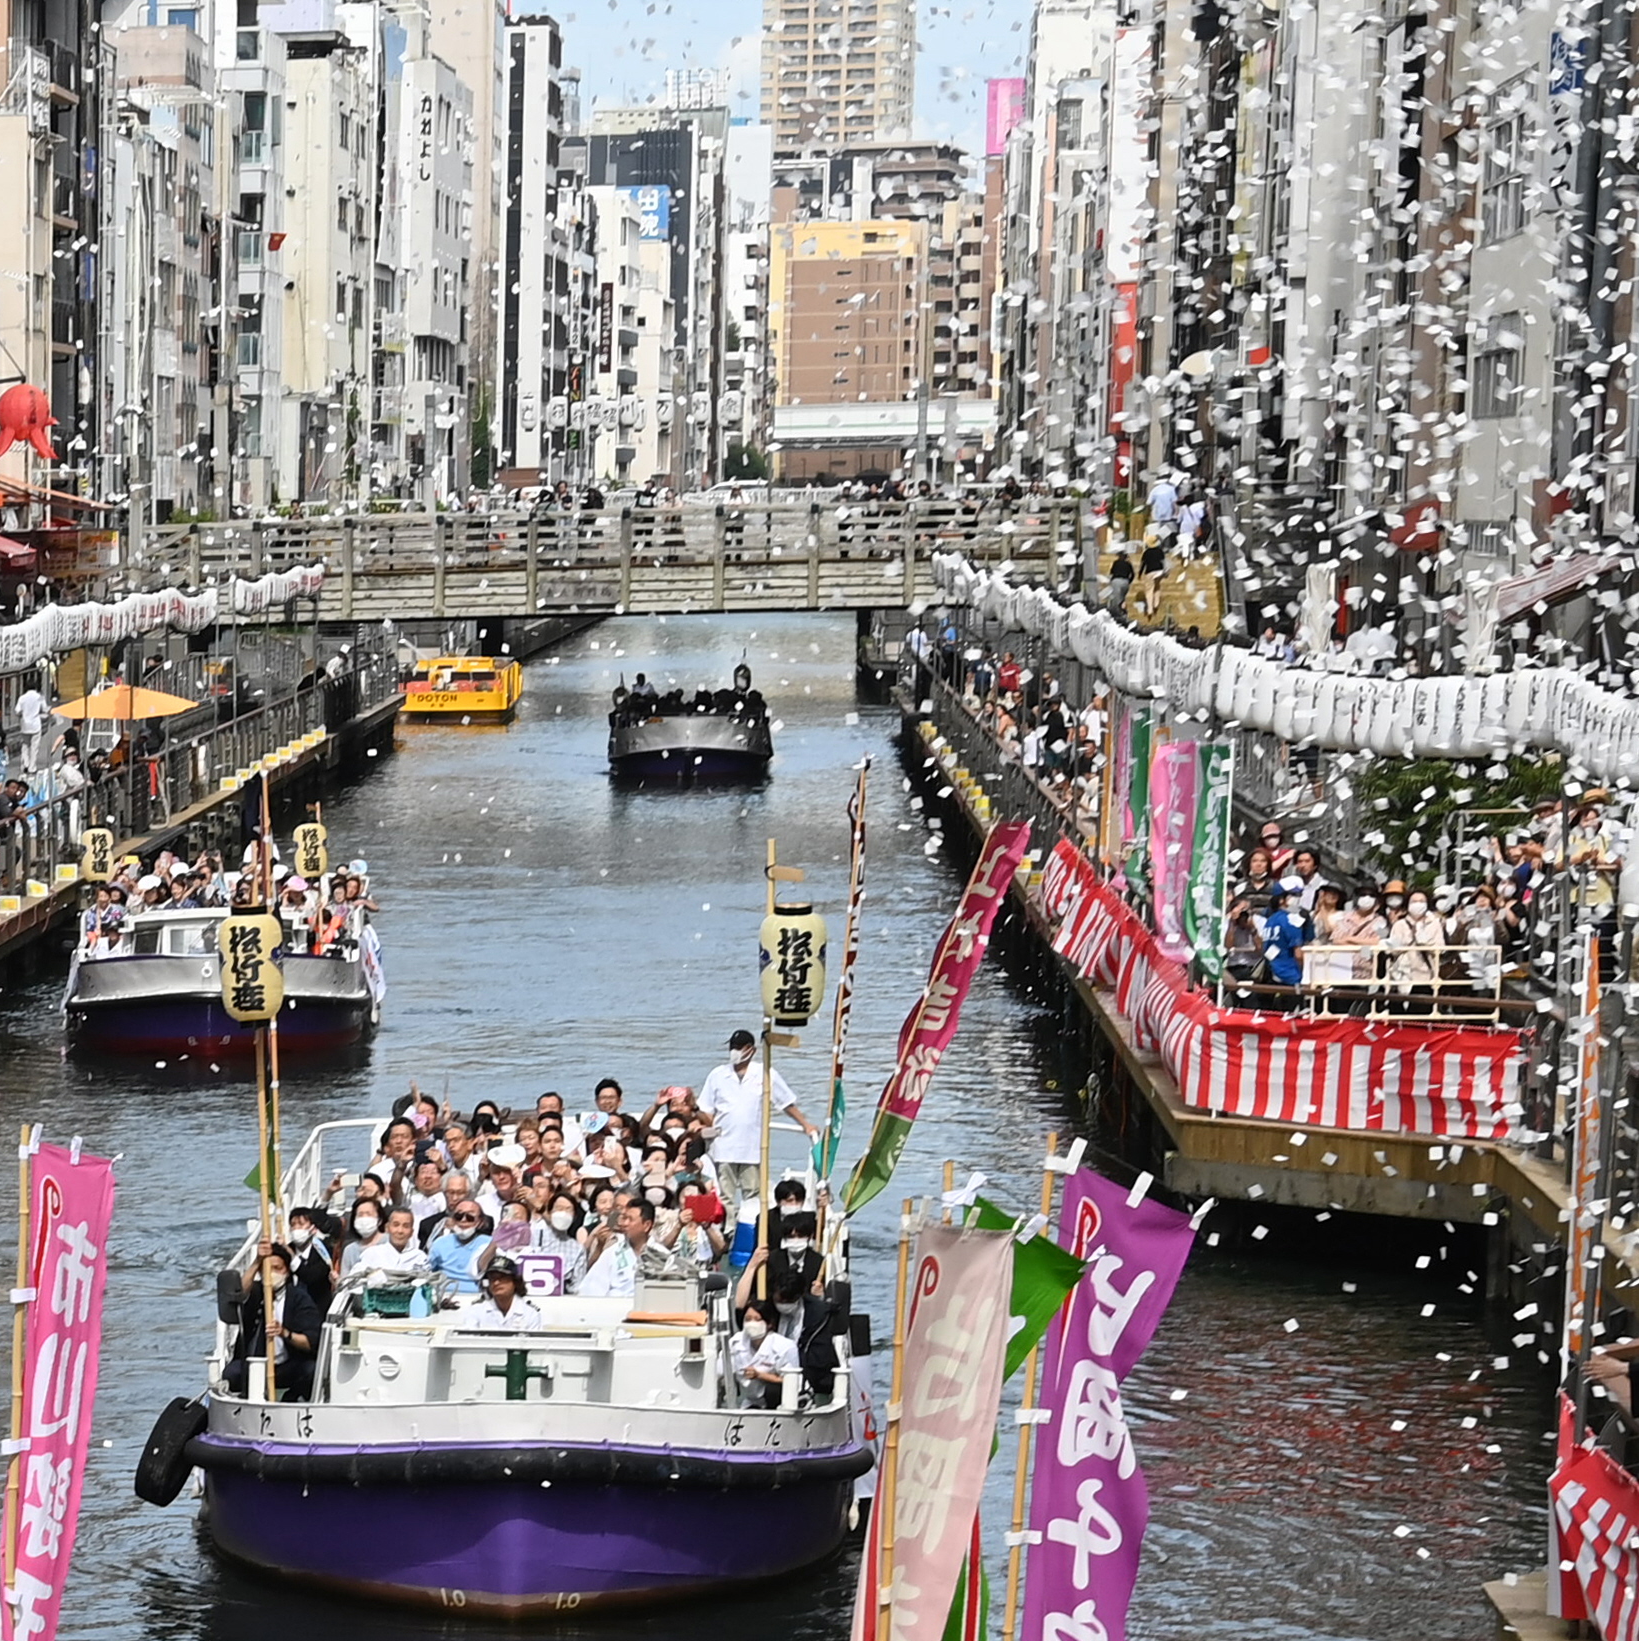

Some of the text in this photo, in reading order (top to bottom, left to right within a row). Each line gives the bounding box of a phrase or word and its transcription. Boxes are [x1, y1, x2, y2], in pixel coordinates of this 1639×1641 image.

[227, 924, 265, 1013] 松竹座
[775, 927, 813, 1015] 松竹座
[524, 1259, 557, 1290] 5
